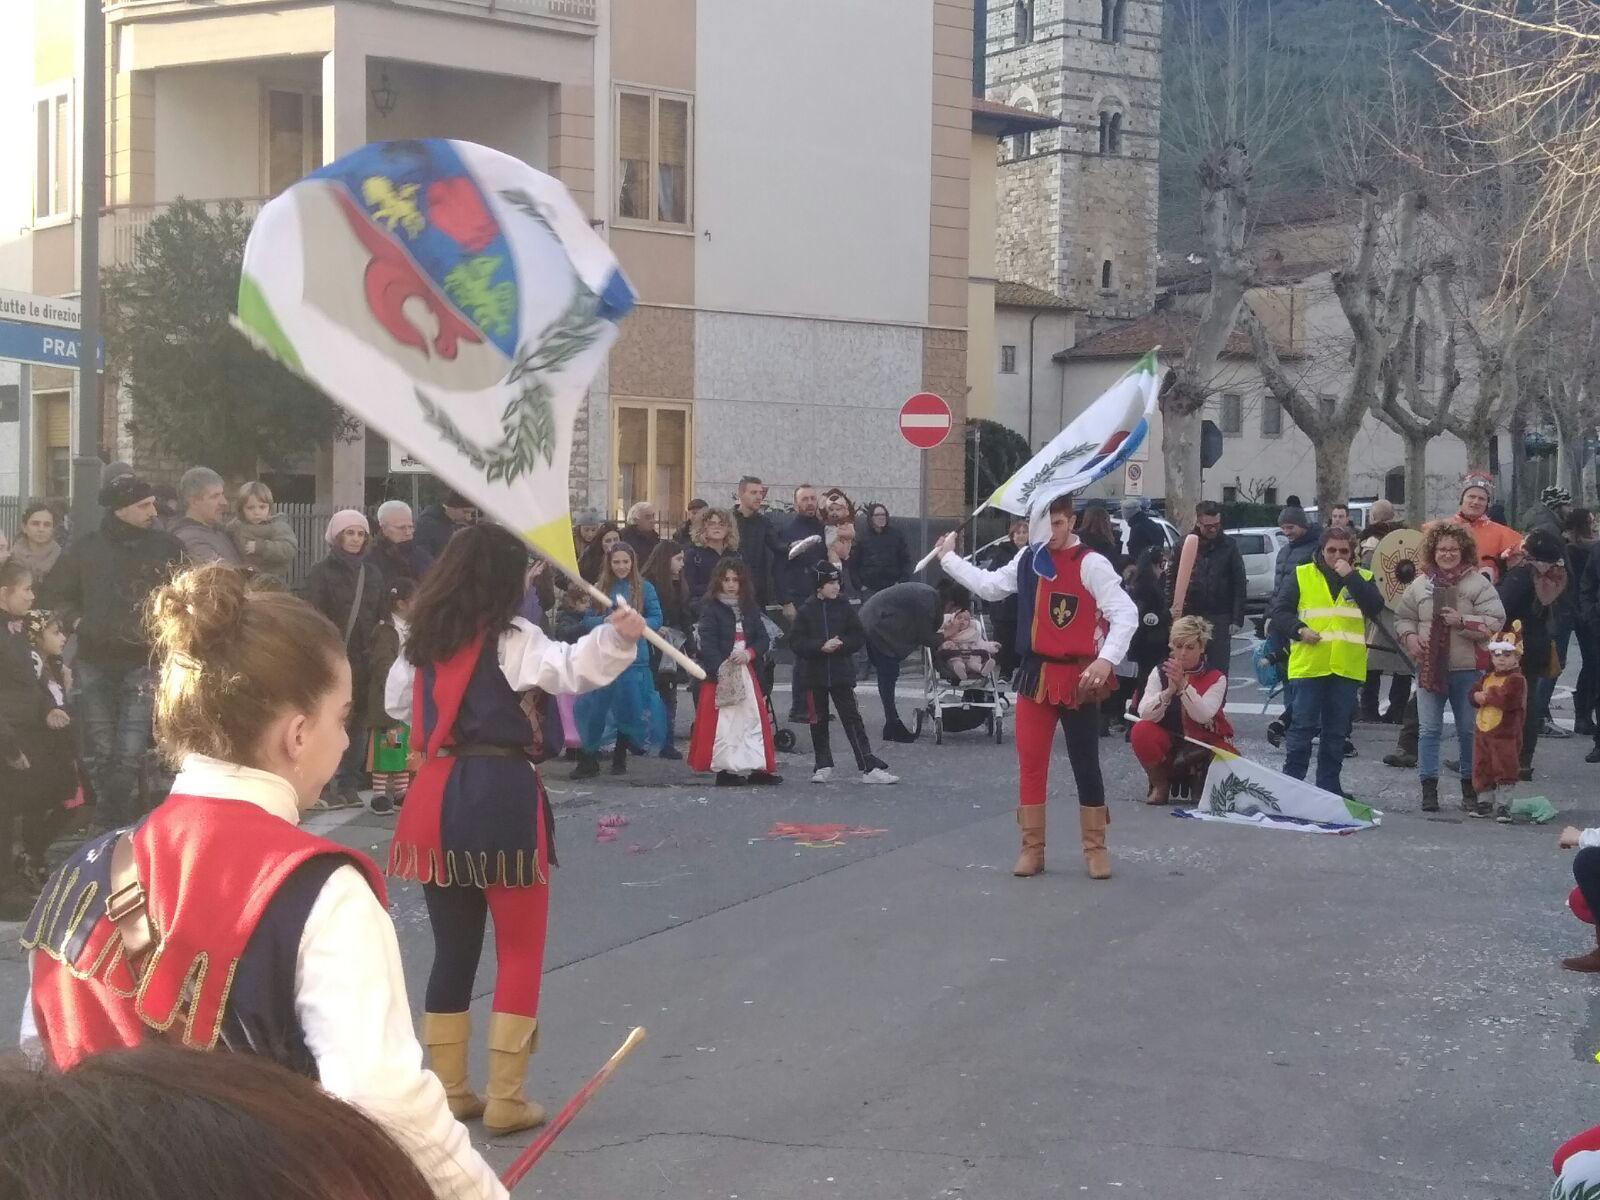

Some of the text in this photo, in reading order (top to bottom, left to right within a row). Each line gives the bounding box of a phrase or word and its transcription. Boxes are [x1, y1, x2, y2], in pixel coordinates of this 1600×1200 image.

[0, 298, 81, 323] tutte le direzion
[42, 337, 100, 359] PRA
